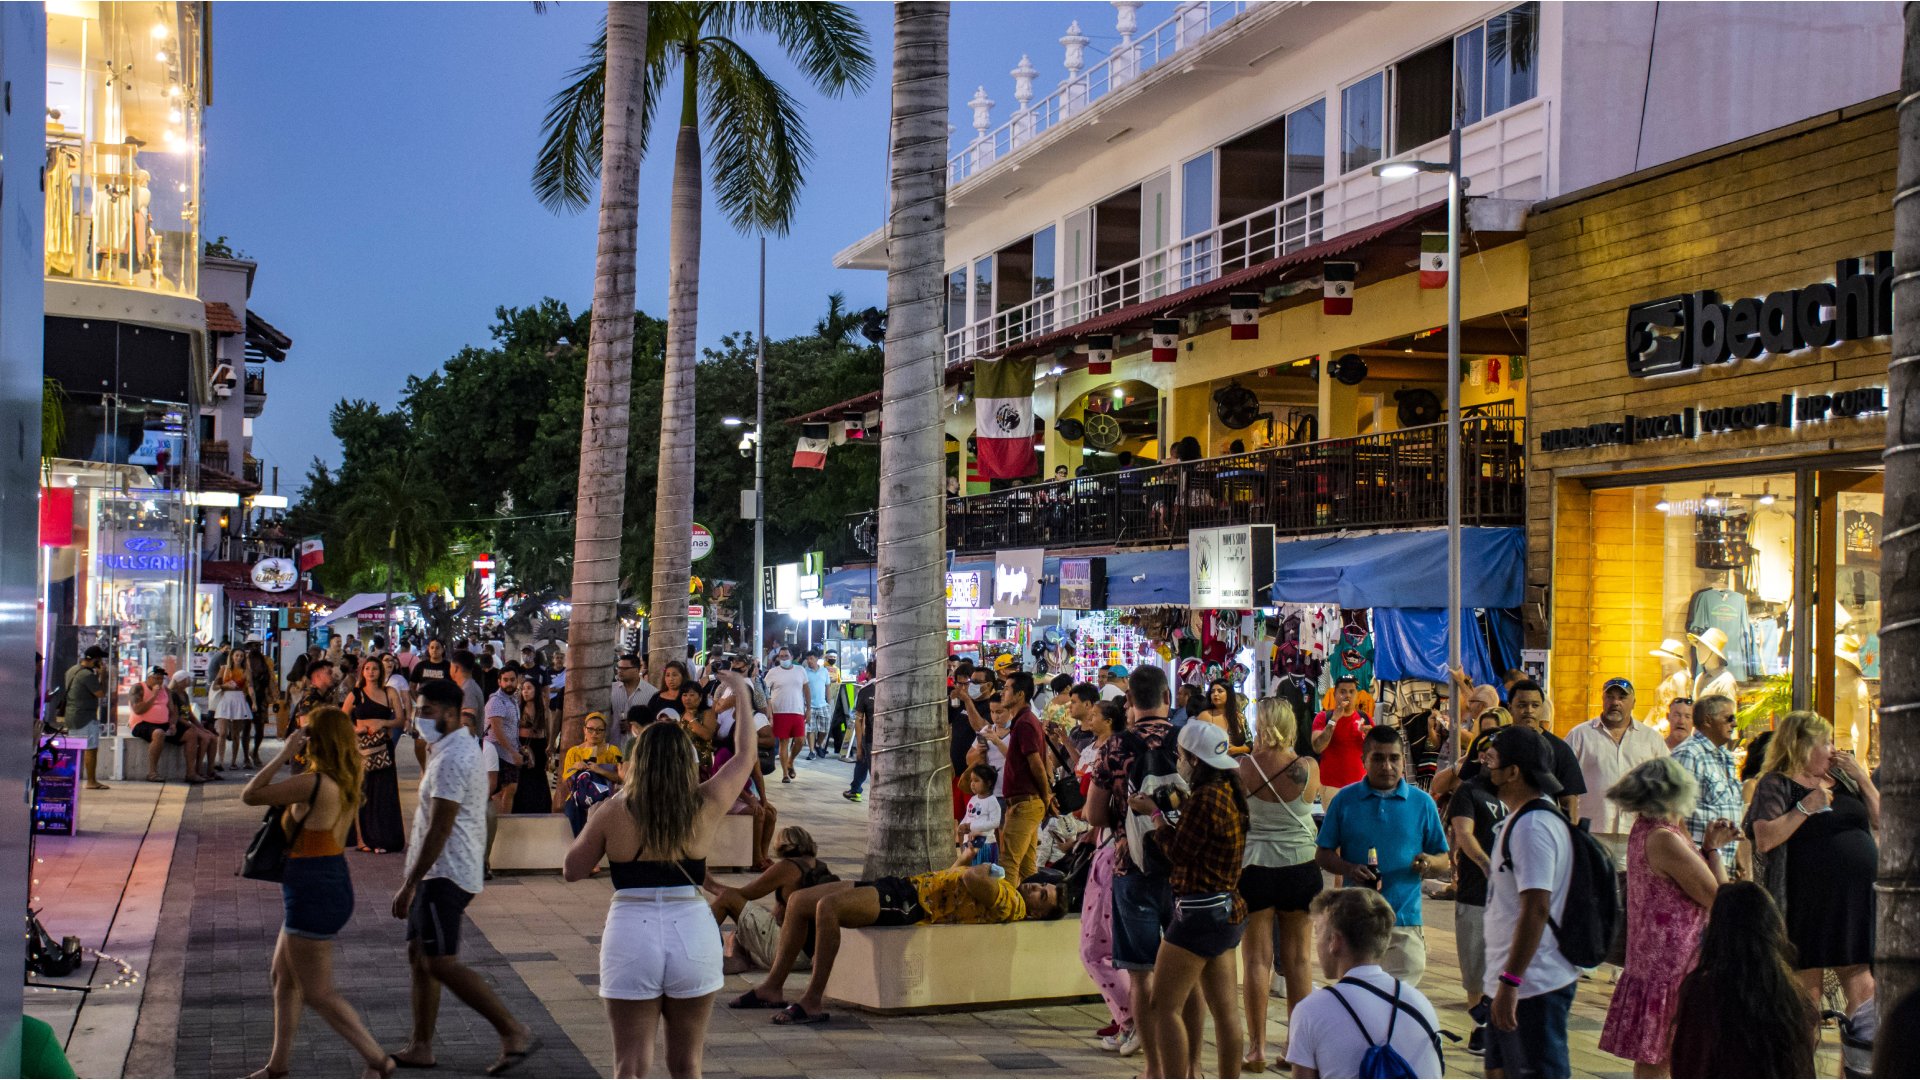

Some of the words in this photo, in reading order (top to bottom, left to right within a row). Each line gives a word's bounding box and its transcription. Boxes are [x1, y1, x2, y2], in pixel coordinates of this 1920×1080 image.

[1541, 421, 1626, 451] BILLABONG
[1634, 413, 1683, 440] RVCA
[1700, 402, 1777, 432] VOLCOM
[1796, 395, 1831, 421] RIP
[1832, 388, 1885, 416] CURL
